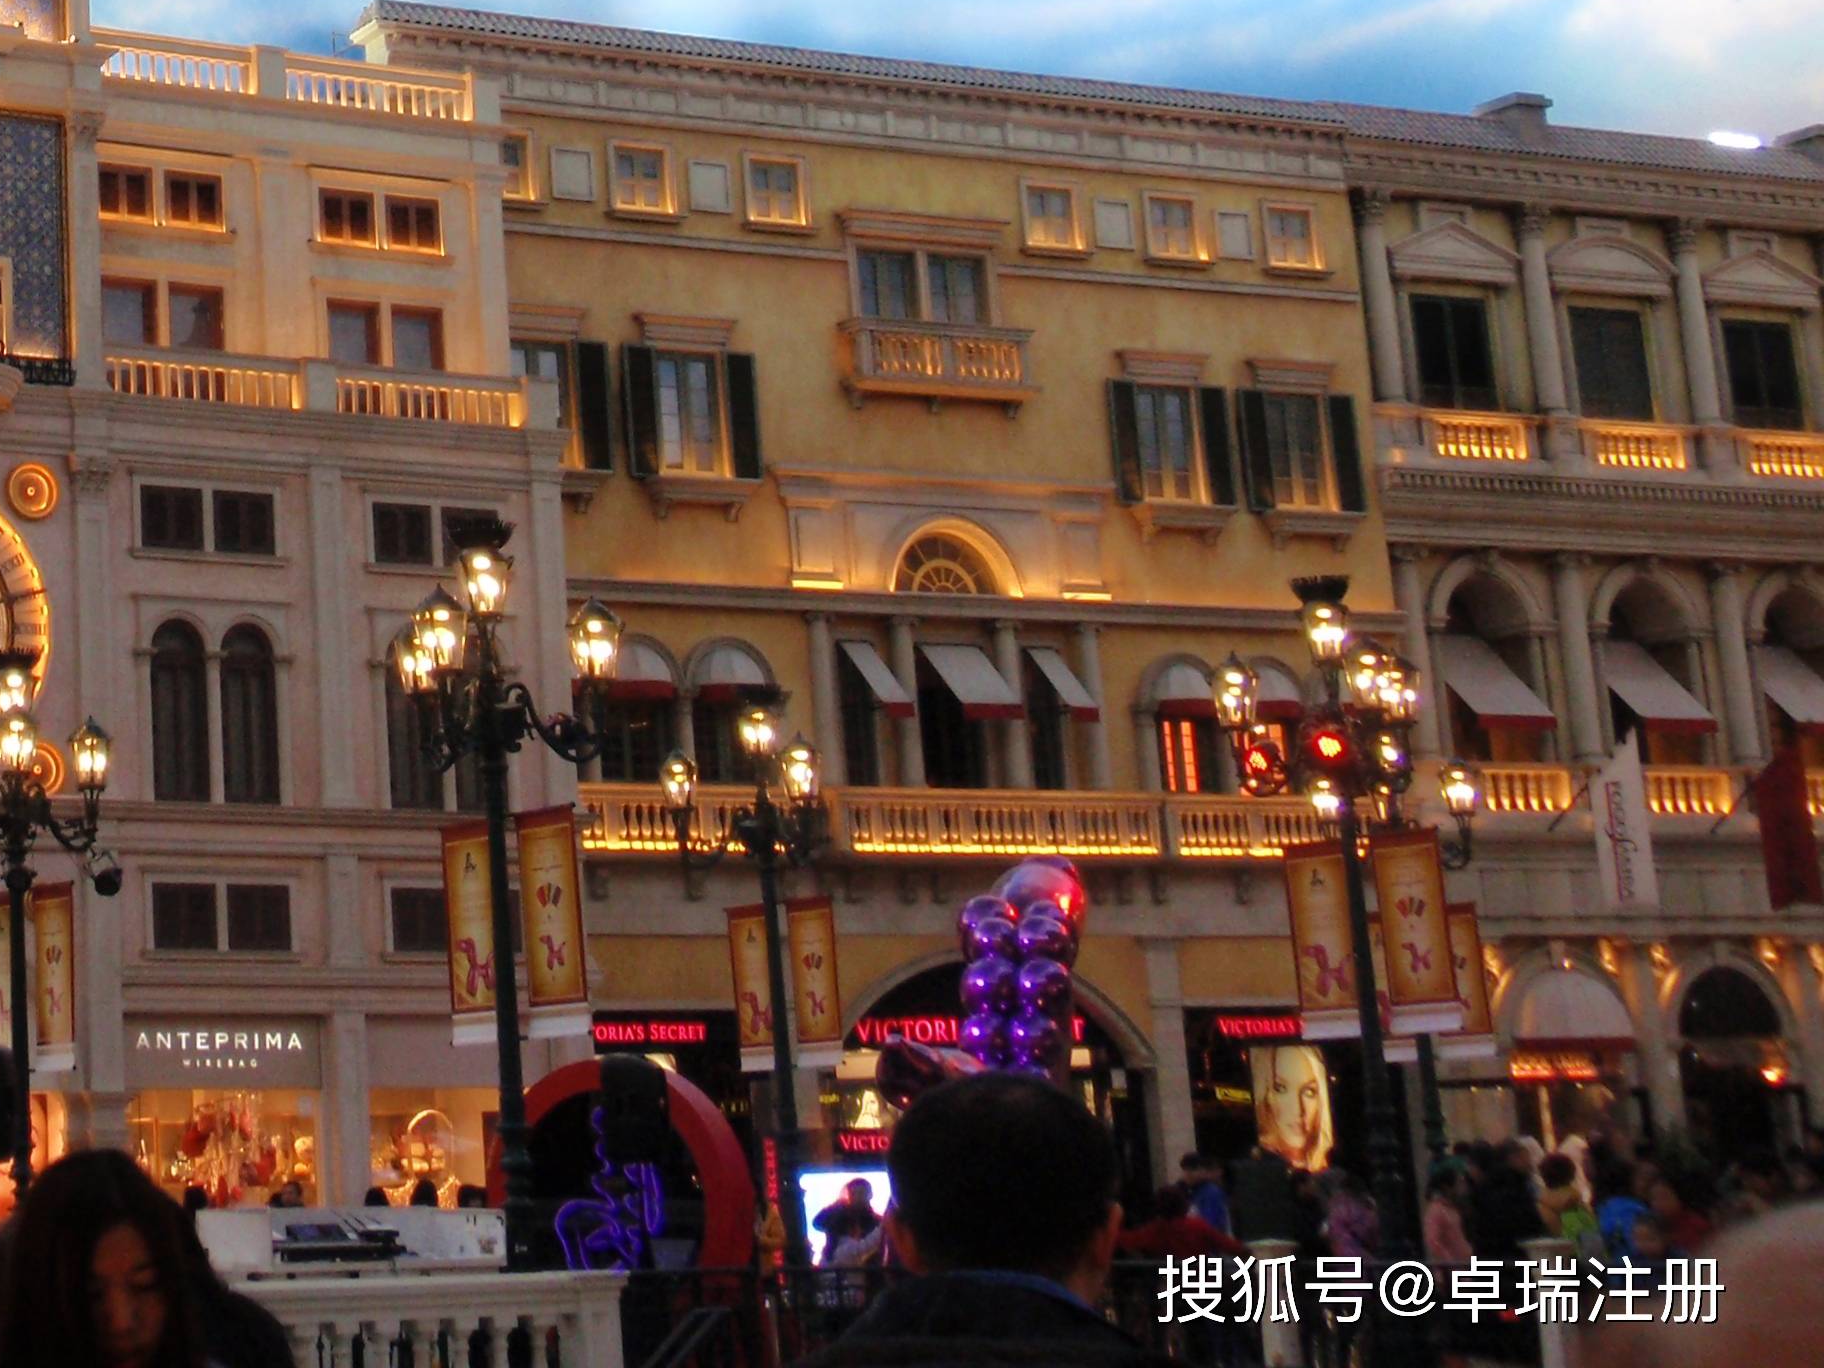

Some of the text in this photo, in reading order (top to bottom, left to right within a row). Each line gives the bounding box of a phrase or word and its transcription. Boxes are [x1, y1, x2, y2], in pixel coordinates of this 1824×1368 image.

[594, 1023, 706, 1041] ORIA'S SECRET
[856, 1017, 959, 1043] VICTORI
[136, 1032, 303, 1051] ANTEPRIMA
[840, 1135, 890, 1151] VICTO
